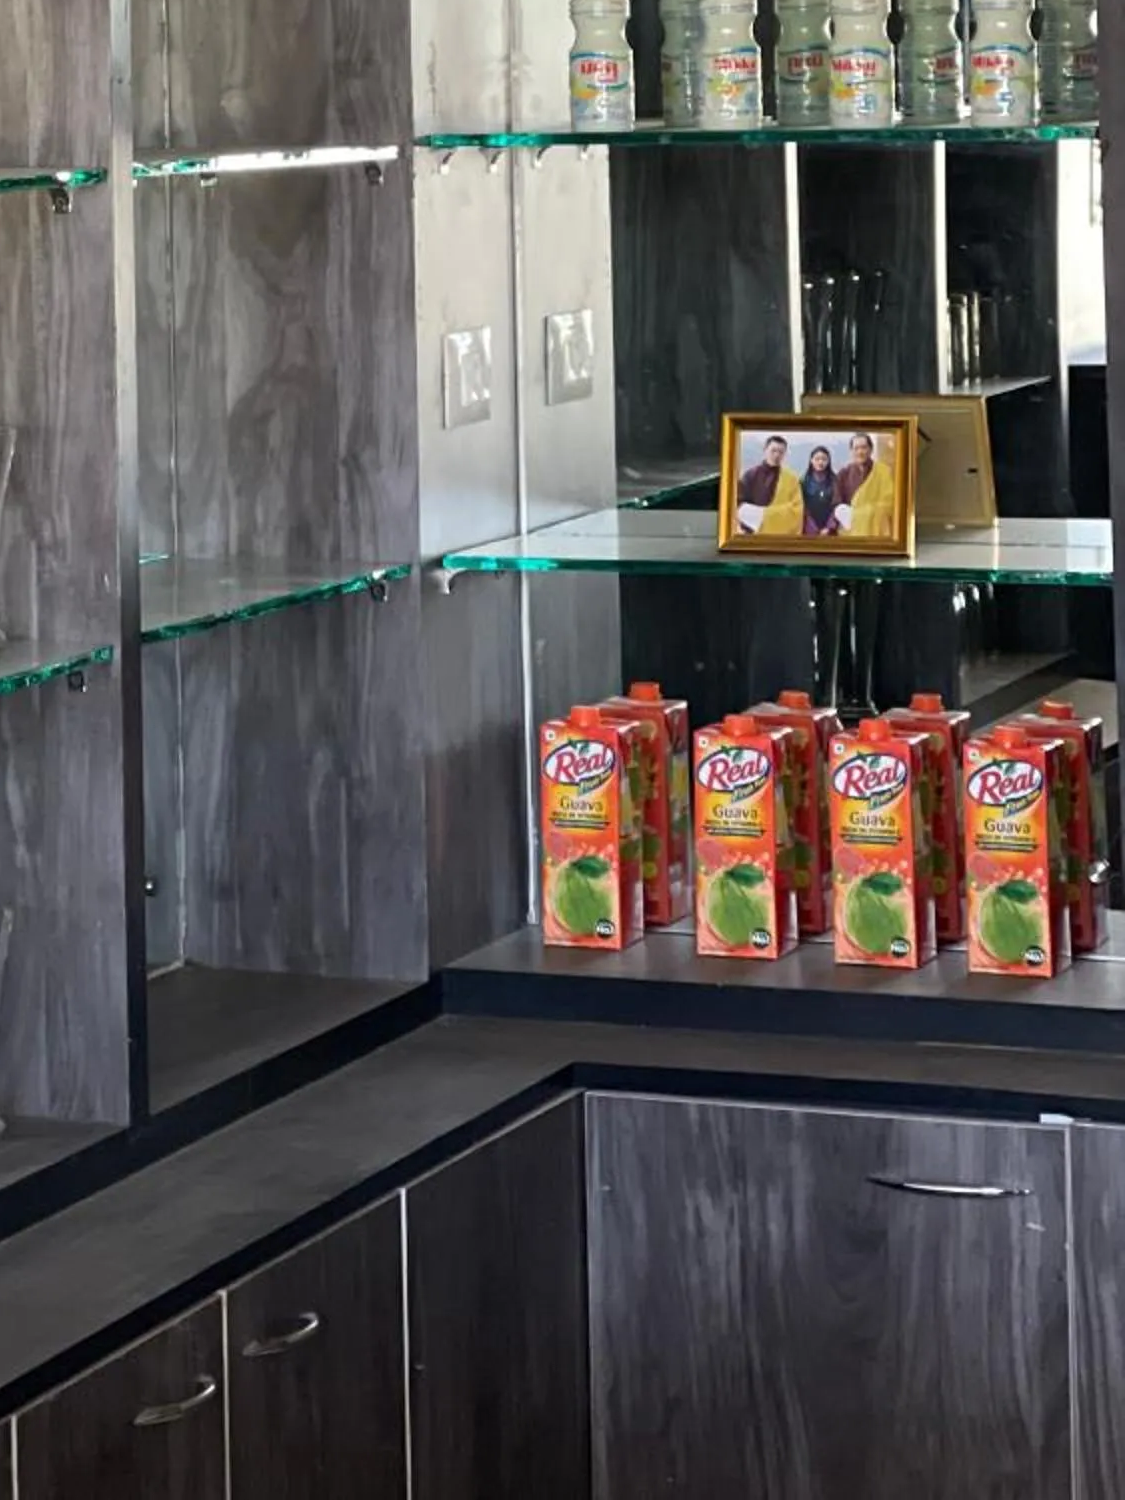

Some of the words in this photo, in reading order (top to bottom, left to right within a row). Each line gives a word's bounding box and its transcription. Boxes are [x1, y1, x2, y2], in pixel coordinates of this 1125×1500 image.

[554, 746, 612, 784] Real
[707, 752, 765, 792] Real
[843, 760, 901, 798] Real
[979, 766, 1037, 805] Real
[559, 795, 603, 812] Guava
[712, 803, 758, 820] Guava
[849, 811, 896, 827] Guava
[984, 819, 1031, 835] Guava
